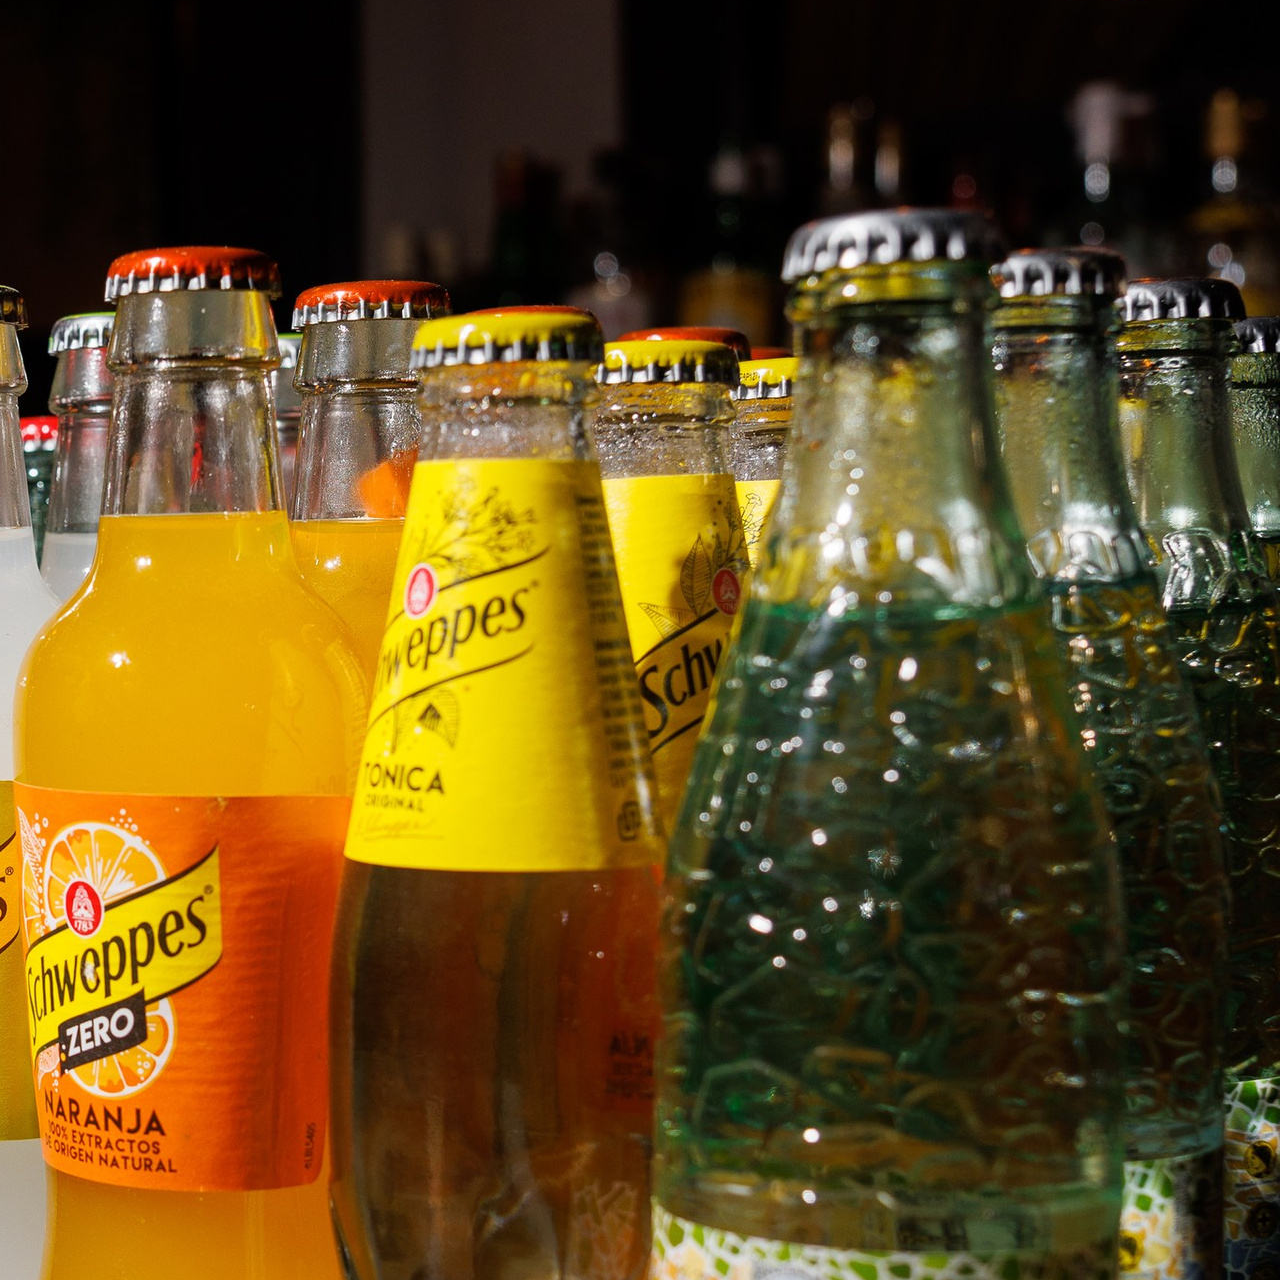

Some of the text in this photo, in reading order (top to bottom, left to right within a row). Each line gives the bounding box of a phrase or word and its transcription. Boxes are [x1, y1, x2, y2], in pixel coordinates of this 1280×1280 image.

[74, 920, 94, 933] 1783
[27, 895, 208, 1046] Schweppes
[66, 1007, 135, 1058] ZERO
[44, 1088, 167, 1137] NARANJA
[48, 1119, 161, 1155] 100% EXTRACTOS
[53, 1138, 94, 1164] ORIGEN
[98, 1152, 178, 1174] NATURAL
